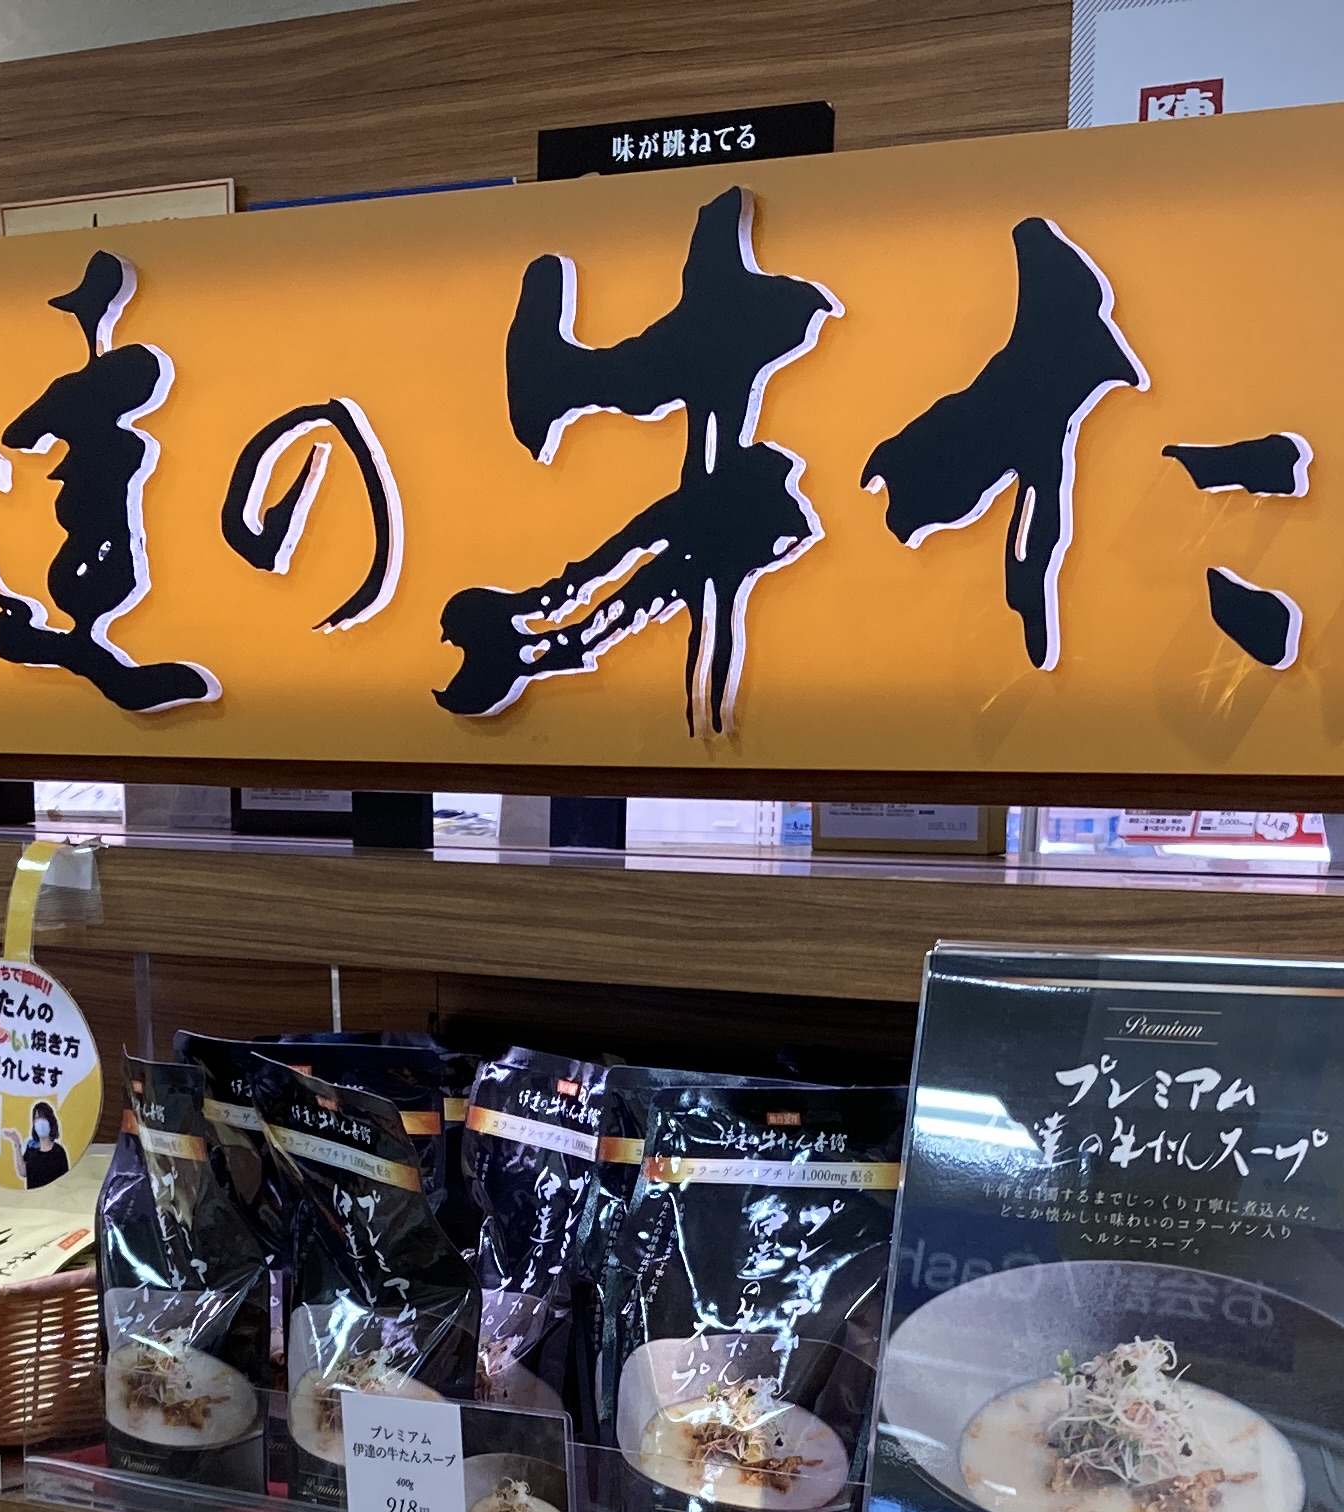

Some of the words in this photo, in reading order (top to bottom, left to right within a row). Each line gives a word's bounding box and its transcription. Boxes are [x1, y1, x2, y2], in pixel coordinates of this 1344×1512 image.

[611, 122, 758, 164] 味が跳ねてる
[1118, 1013, 1204, 1040] Premium
[1055, 1054, 1256, 1110] プレミアム
[991, 1112, 1330, 1183] 達の牛たんスープ
[999, 1202, 1294, 1241] どこか懐かしい味わいのコラーゲン入り
[1080, 1230, 1202, 1256] ヘルシースープ。
[370, 1425, 432, 1446] プレミアム
[352, 1442, 457, 1468] 伊達の牛たんスープ
[395, 1476, 415, 1491] 400g
